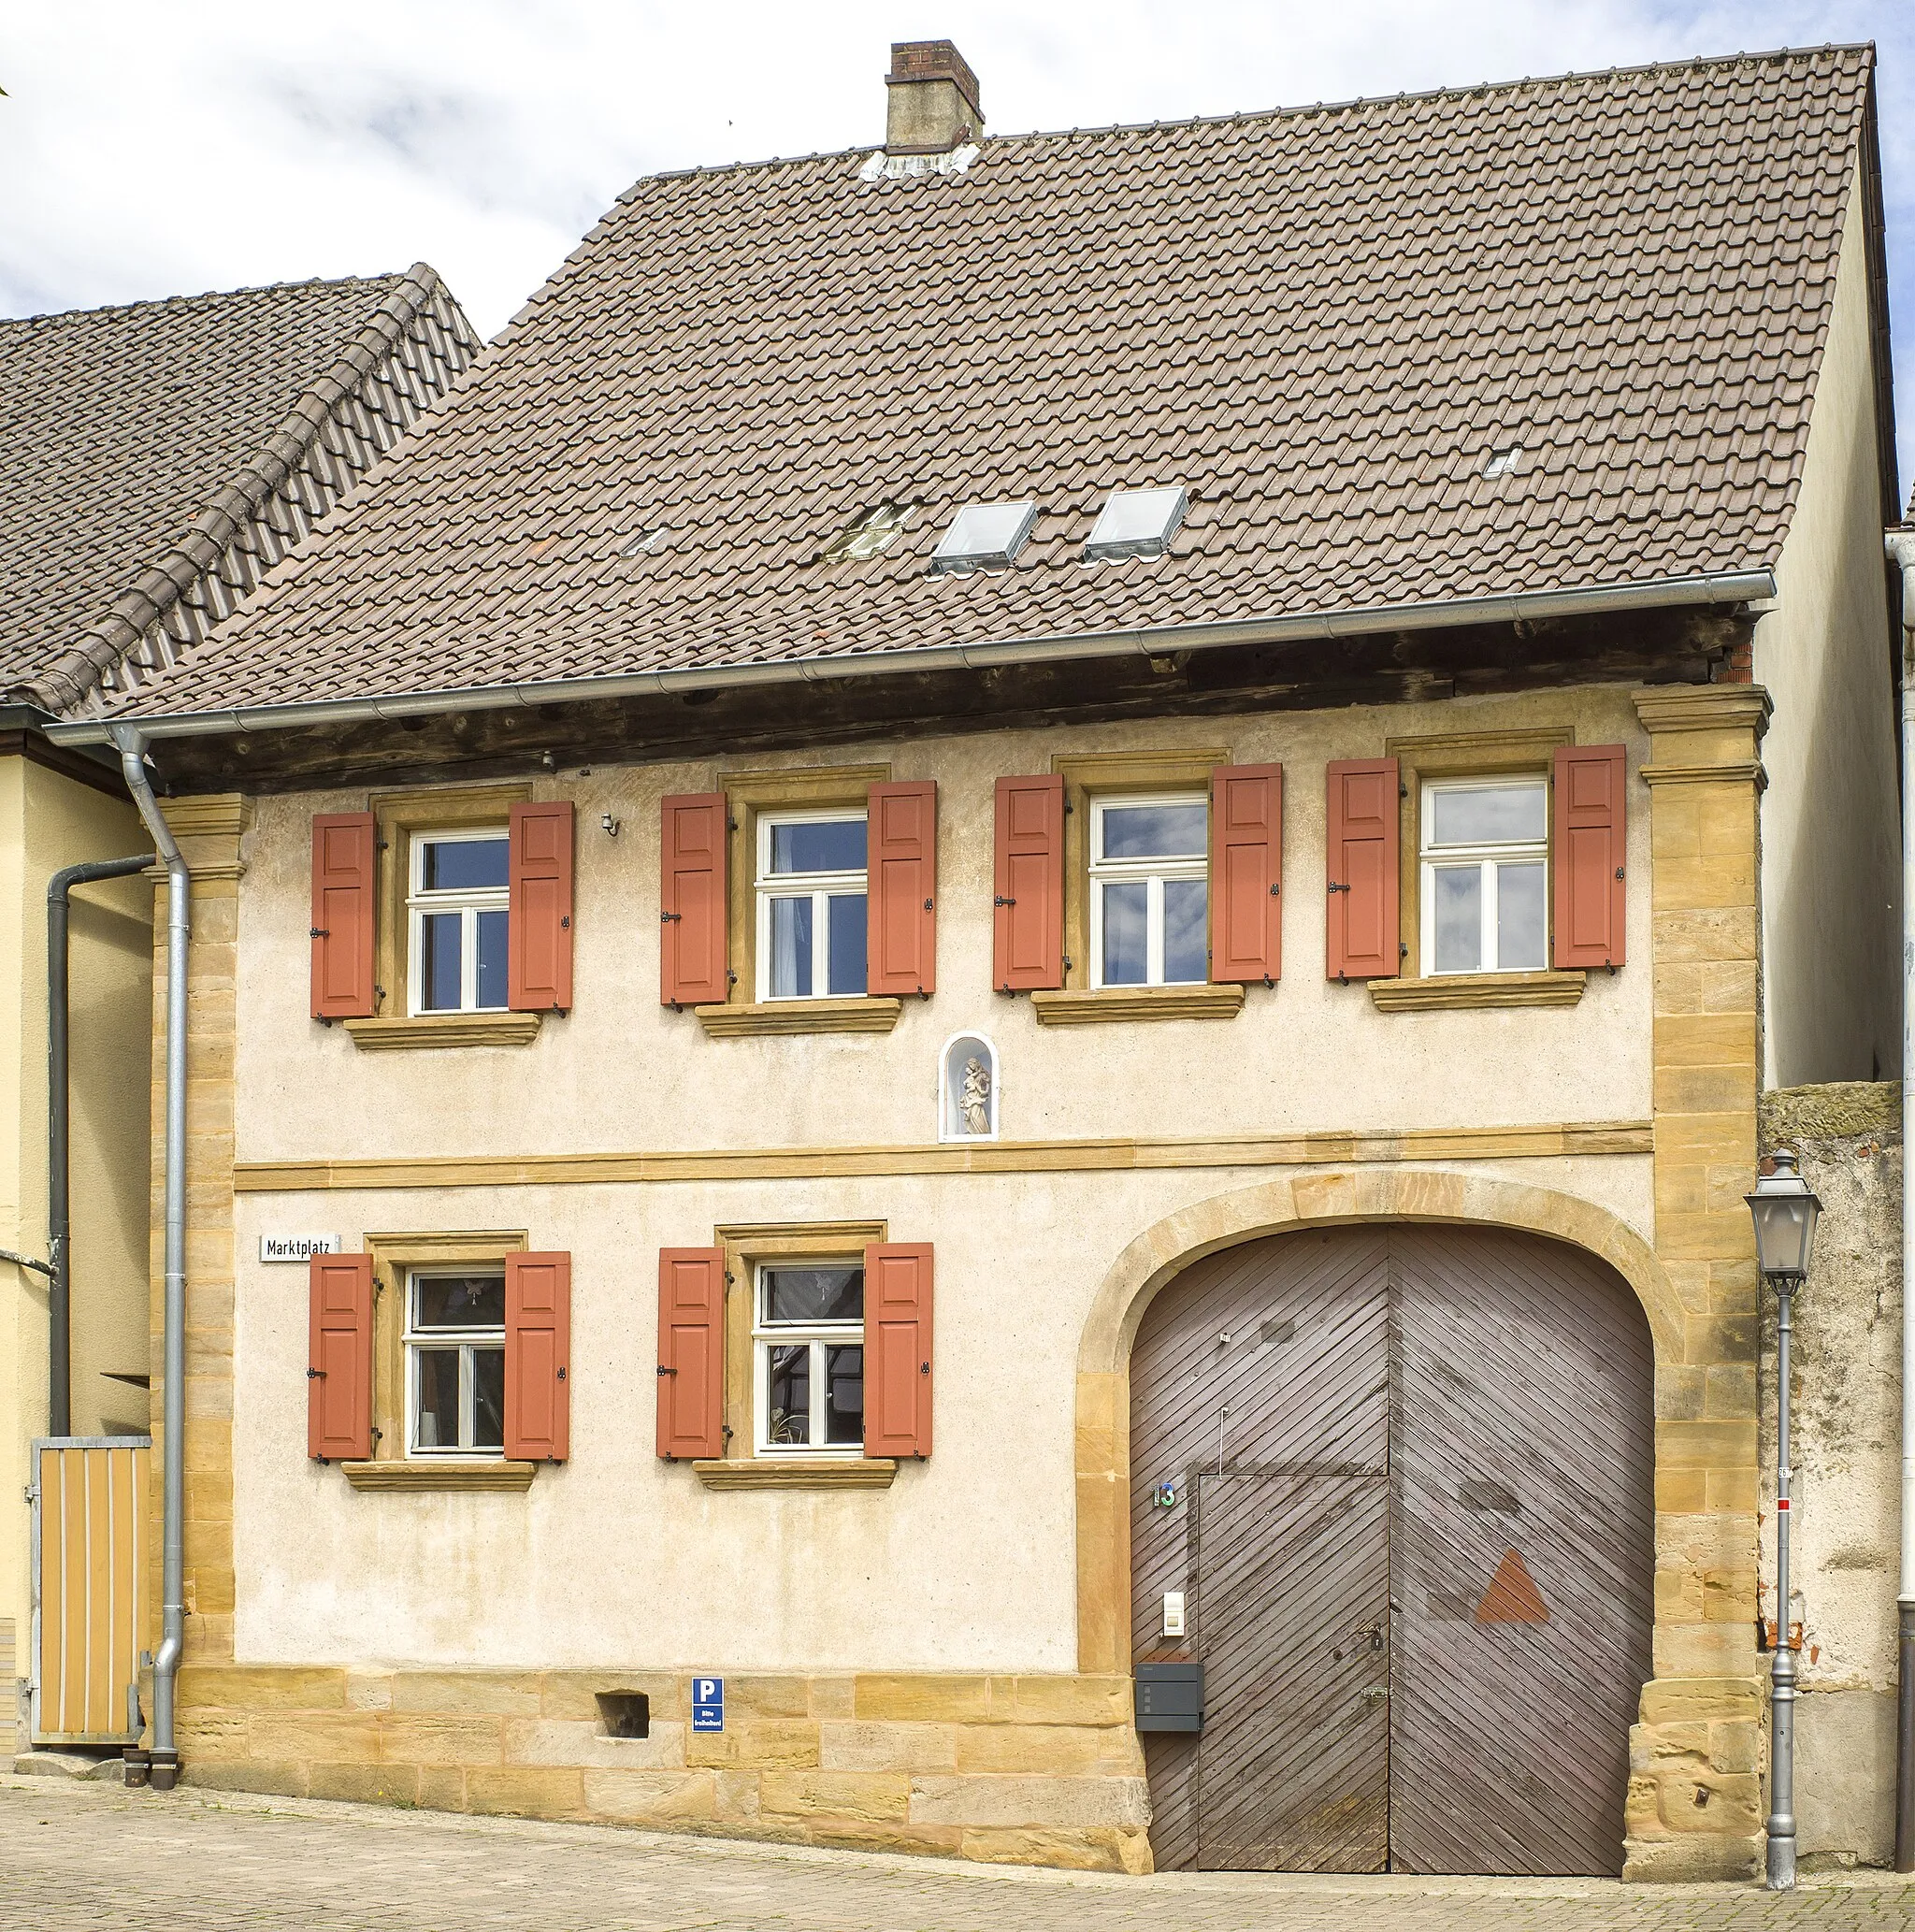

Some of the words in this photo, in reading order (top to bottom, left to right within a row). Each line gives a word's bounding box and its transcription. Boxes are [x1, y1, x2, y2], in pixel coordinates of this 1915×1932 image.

[267, 1239, 330, 1259] Marktplatz
[1150, 1482, 1174, 1507] 13
[699, 1680, 715, 1702] P
